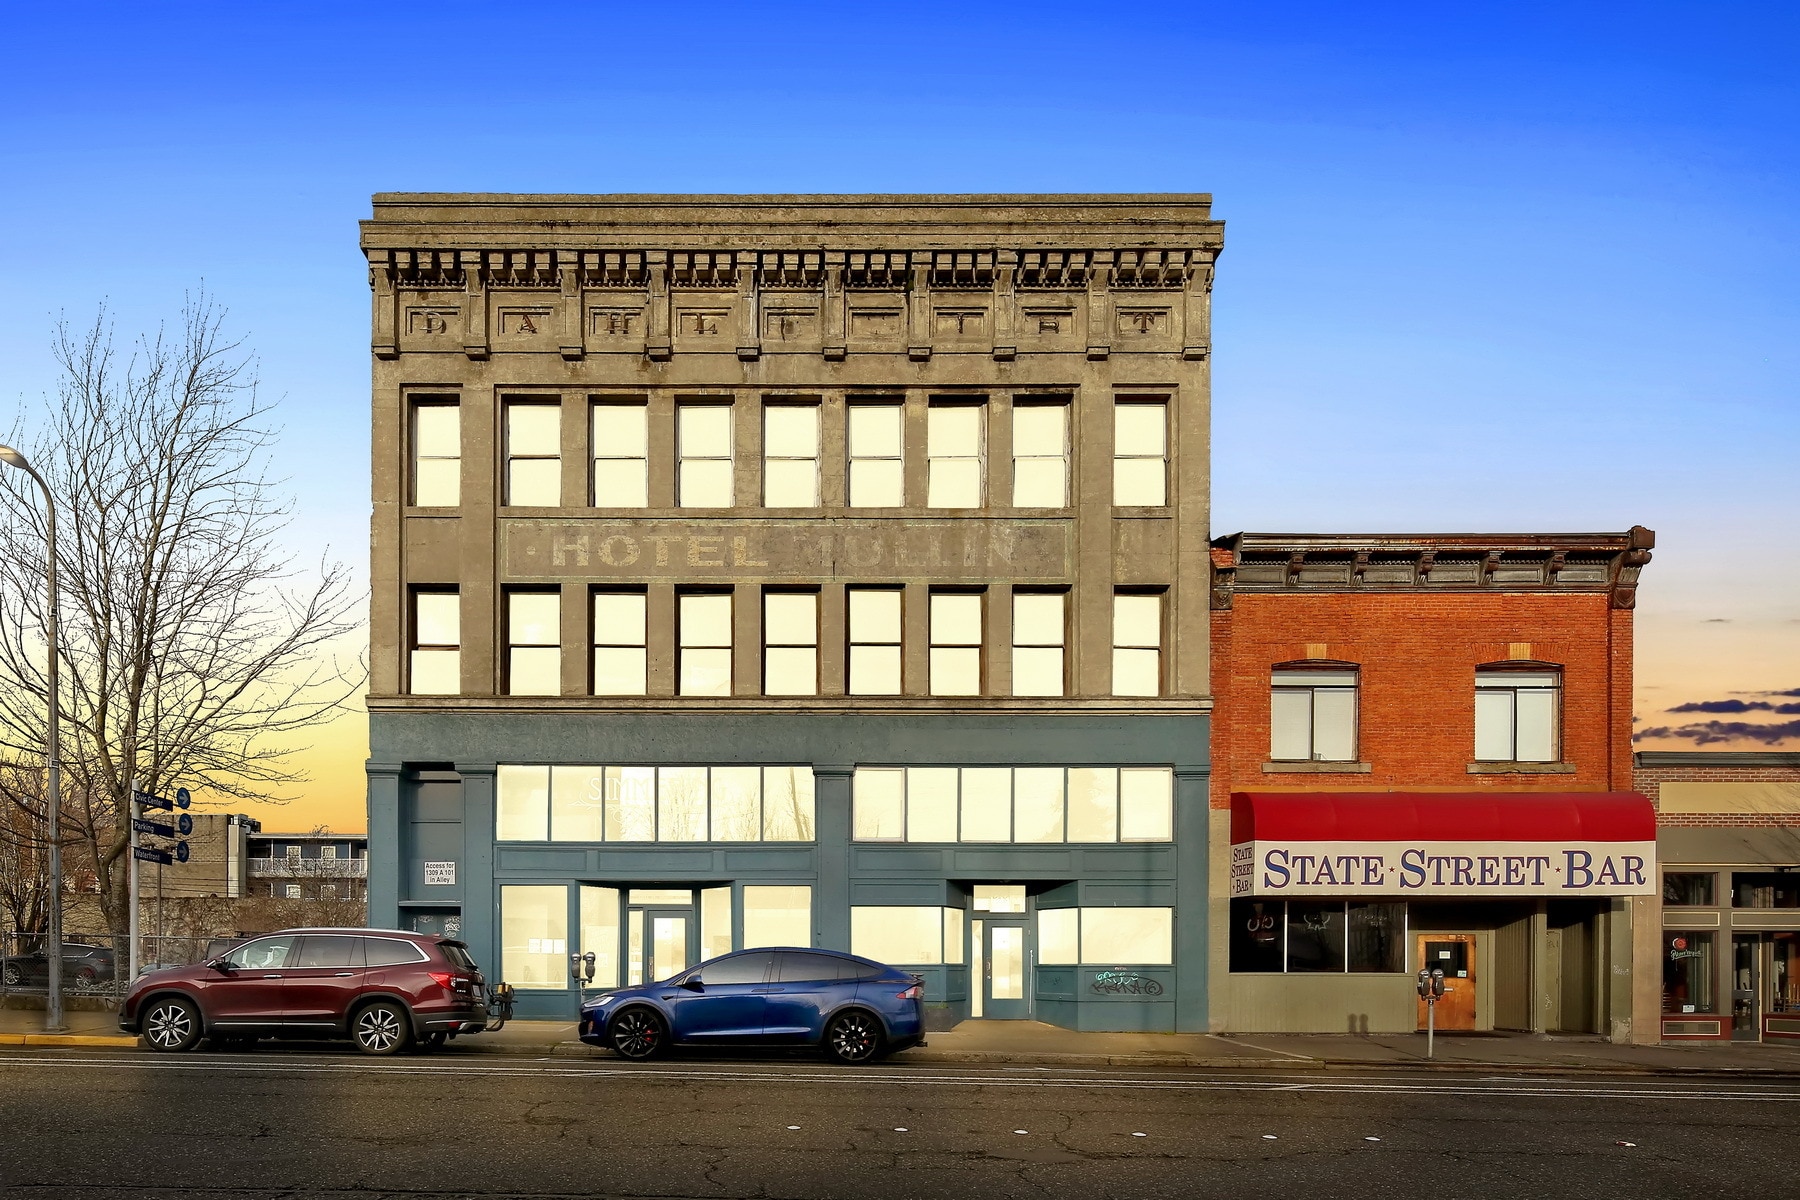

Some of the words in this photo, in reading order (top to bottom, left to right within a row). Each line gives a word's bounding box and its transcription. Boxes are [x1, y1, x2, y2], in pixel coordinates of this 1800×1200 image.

[552, 535, 769, 568] HOTEL
[135, 792, 148, 803] Civic
[147, 796, 164, 807] Center
[134, 821, 155, 834] Parking
[135, 849, 161, 861] Waterfront
[1232, 846, 1253, 863] STATE
[1231, 862, 1255, 879] STREET
[1264, 849, 1385, 889] STATE
[1399, 848, 1550, 889] STREET
[1561, 850, 1647, 889] BAR
[1235, 879, 1249, 894] BAR
